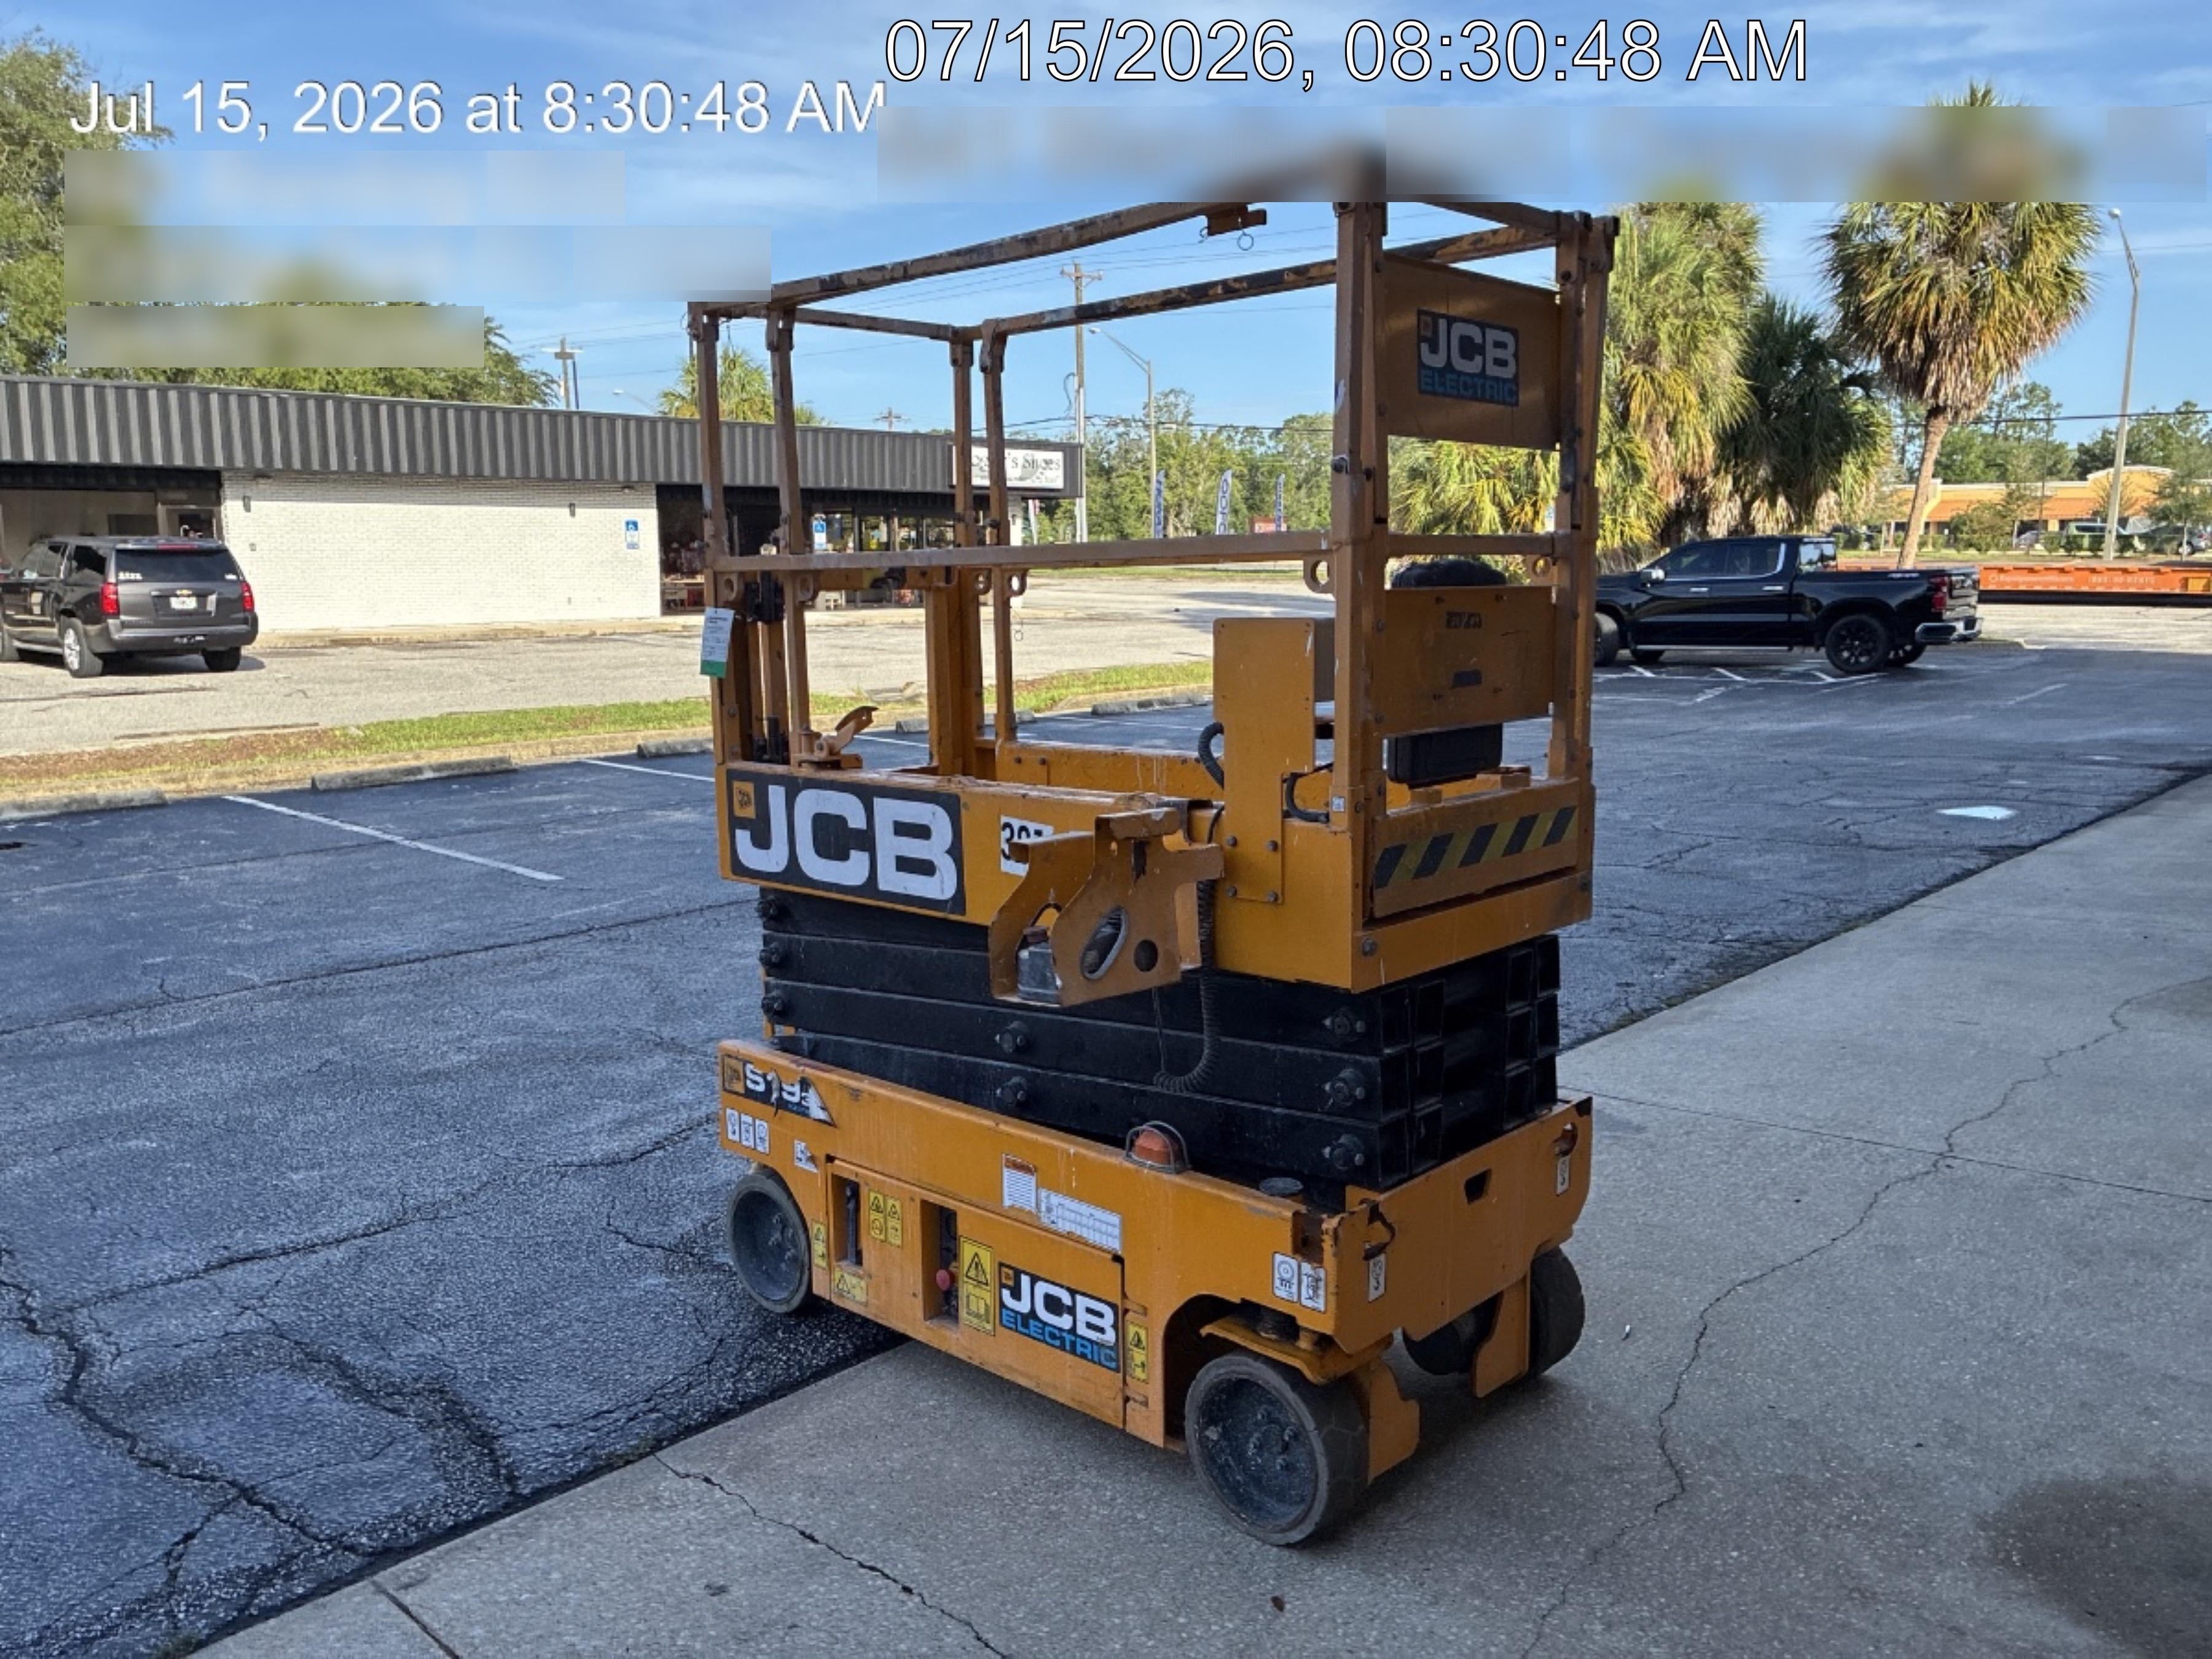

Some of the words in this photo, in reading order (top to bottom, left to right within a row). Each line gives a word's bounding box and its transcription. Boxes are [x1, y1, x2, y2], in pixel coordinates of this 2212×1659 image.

[1421, 318, 1516, 378] JCB
[1421, 369, 1516, 405] ELECTRIC
[735, 785, 958, 900] JCB
[1002, 1273, 1116, 1346] JCB
[1002, 1308, 1117, 1370] ELECTRIC
